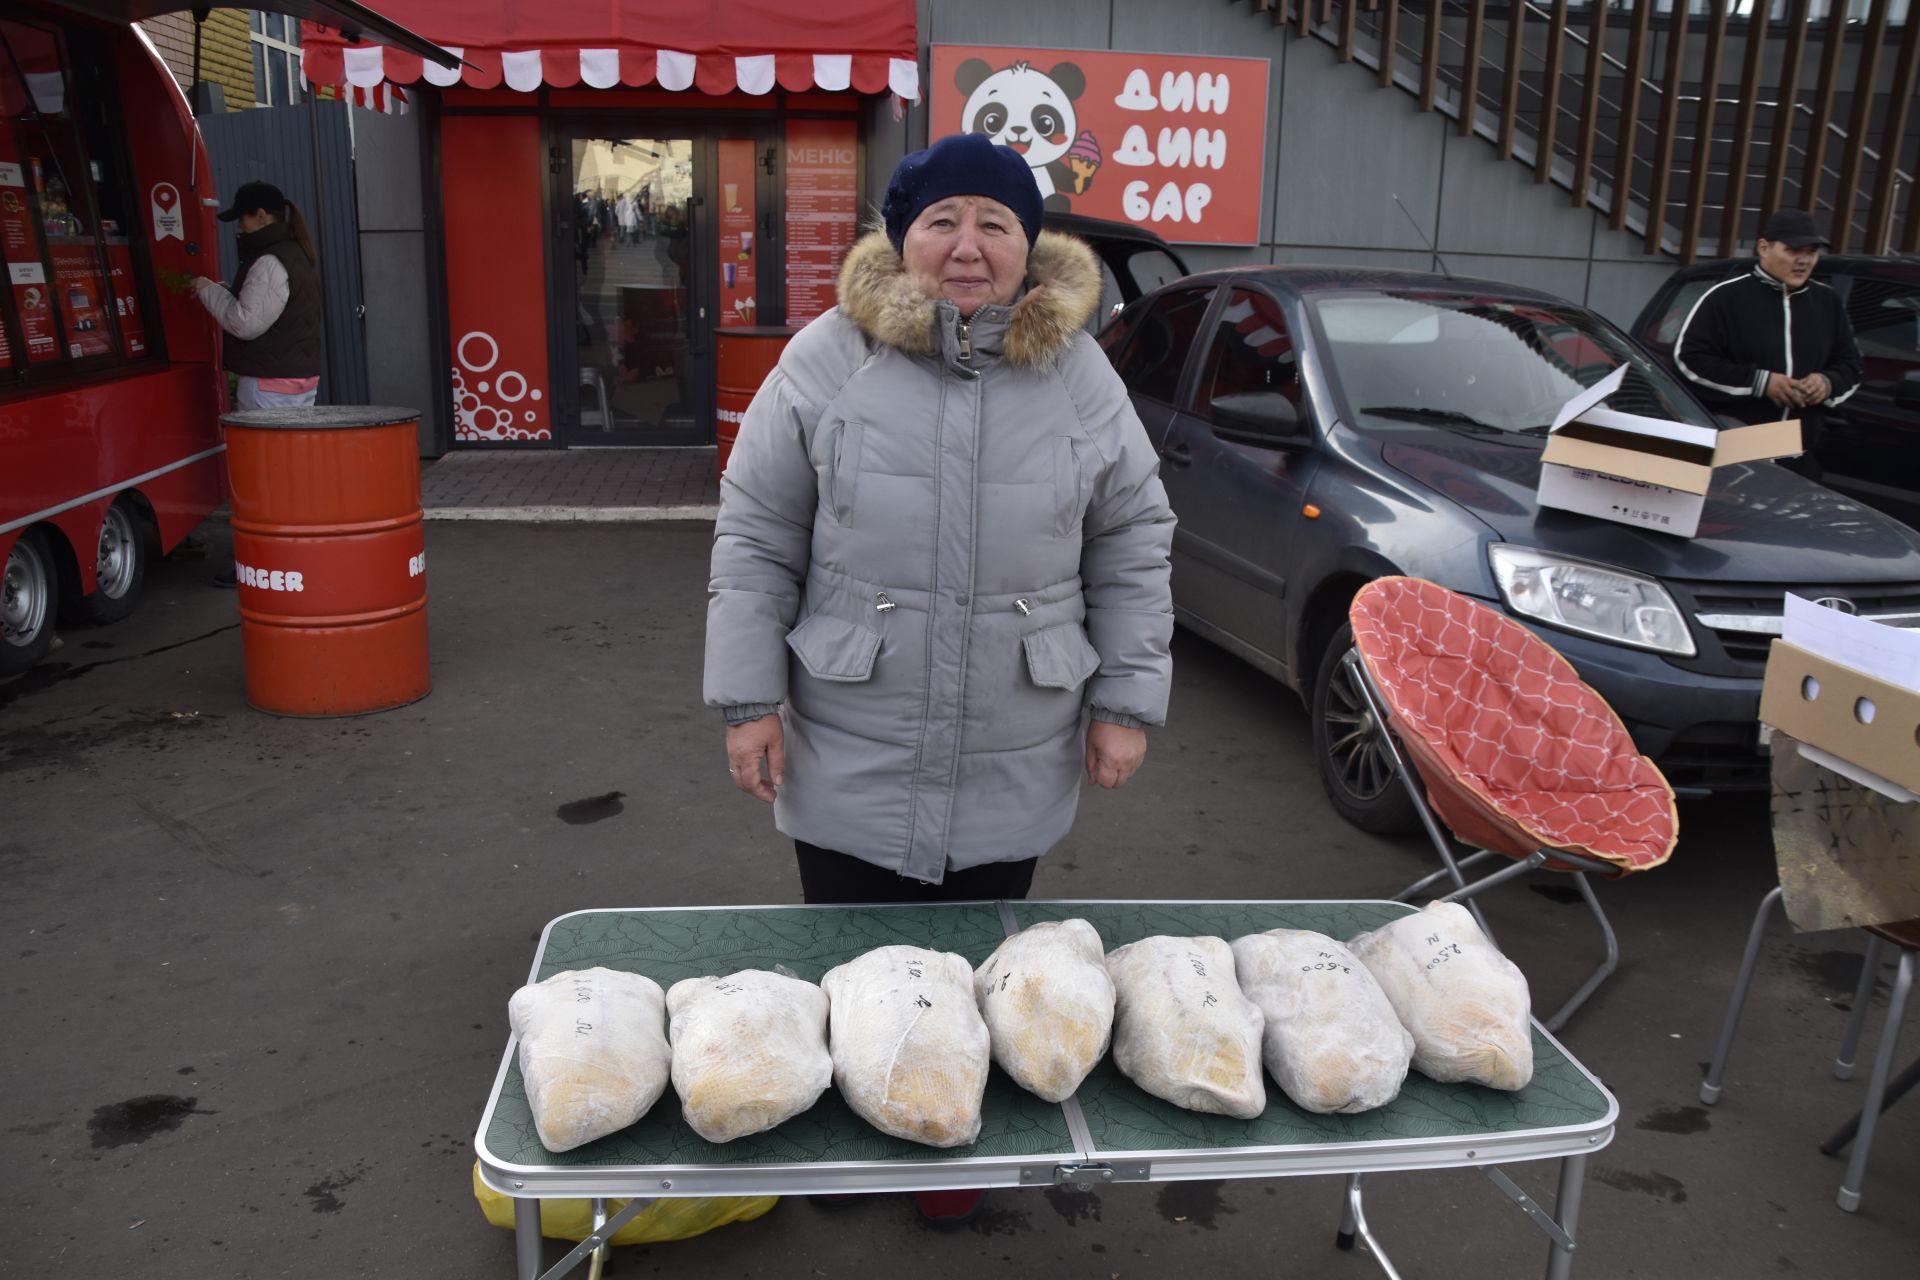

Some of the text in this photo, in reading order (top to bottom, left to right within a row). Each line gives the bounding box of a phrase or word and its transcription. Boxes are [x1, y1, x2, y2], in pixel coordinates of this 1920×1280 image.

[1114, 68, 1231, 115] ДИН
[787, 148, 855, 165] МЕНЮ
[1112, 124, 1227, 170] ДИН
[1122, 179, 1213, 224] БАР
[235, 560, 304, 592] URGER
